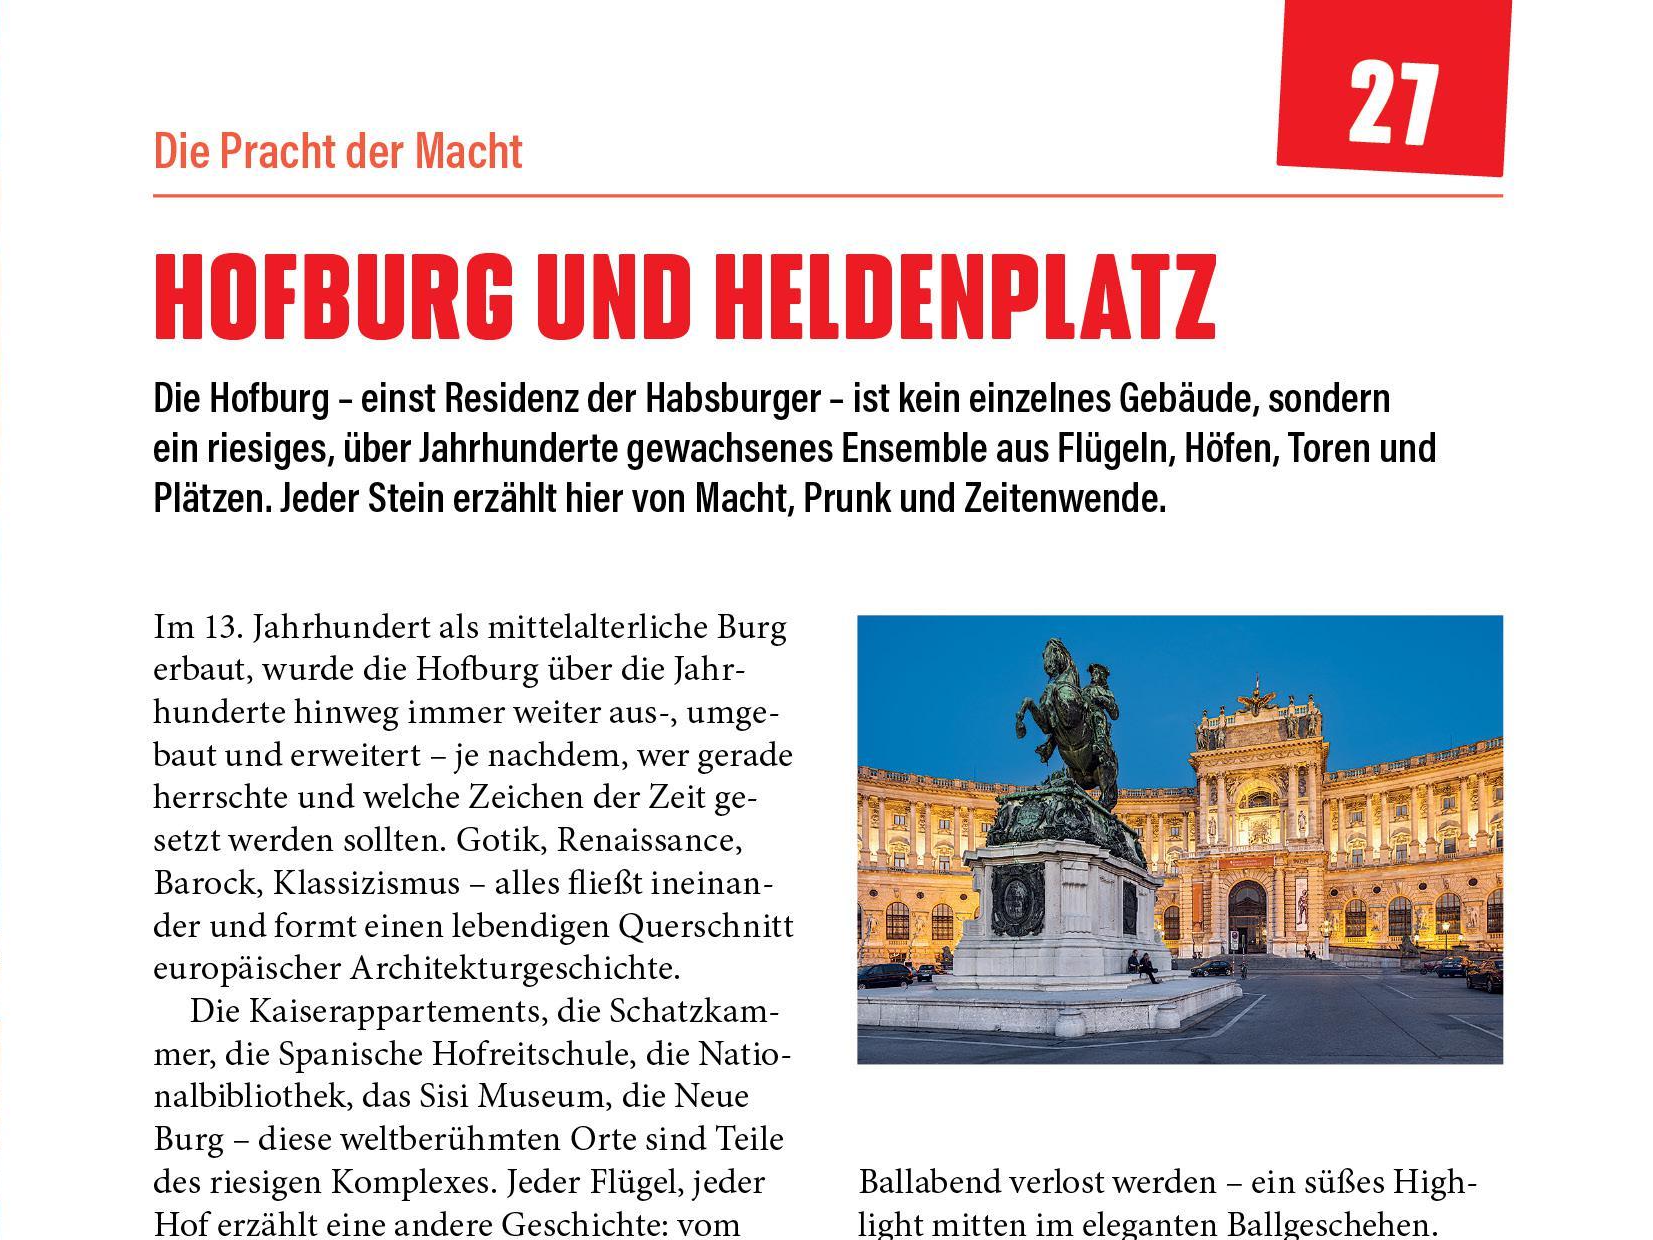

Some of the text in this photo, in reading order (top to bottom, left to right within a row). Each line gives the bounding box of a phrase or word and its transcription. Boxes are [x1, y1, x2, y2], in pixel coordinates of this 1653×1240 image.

[1349, 59, 1439, 145] 27
[156, 132, 522, 168] Die Pracht der Macht
[156, 253, 1216, 340] HOFBURG UND HELDENPLATZ
[155, 382, 200, 412] Die
[211, 382, 328, 420] Hofburg
[362, 382, 436, 412] einst
[446, 382, 579, 412] Residenz
[588, 382, 636, 412] der
[647, 382, 821, 420] Habsburger
[855, 382, 890, 412] ist
[900, 382, 959, 412] kein
[970, 382, 1111, 412] einzelnes
[1120, 382, 1259, 417] Gebäude,
[1269, 382, 1389, 412] sondern
[154, 432, 1435, 470] ein riesiges, über Jahrhunderte gewachsenes Ensemble aus Flügeln, Höfen, Toren und
[155, 482, 1165, 517] Plätzen. Jeder Stein erzählt hier von Macht, Prunk und Zeitenwende.
[155, 613, 786, 646] Im 13. Jahrhundert als mittelalterliche Burg
[932, 1213, 1026, 1236] mitten
[1036, 1213, 1073, 1236] im
